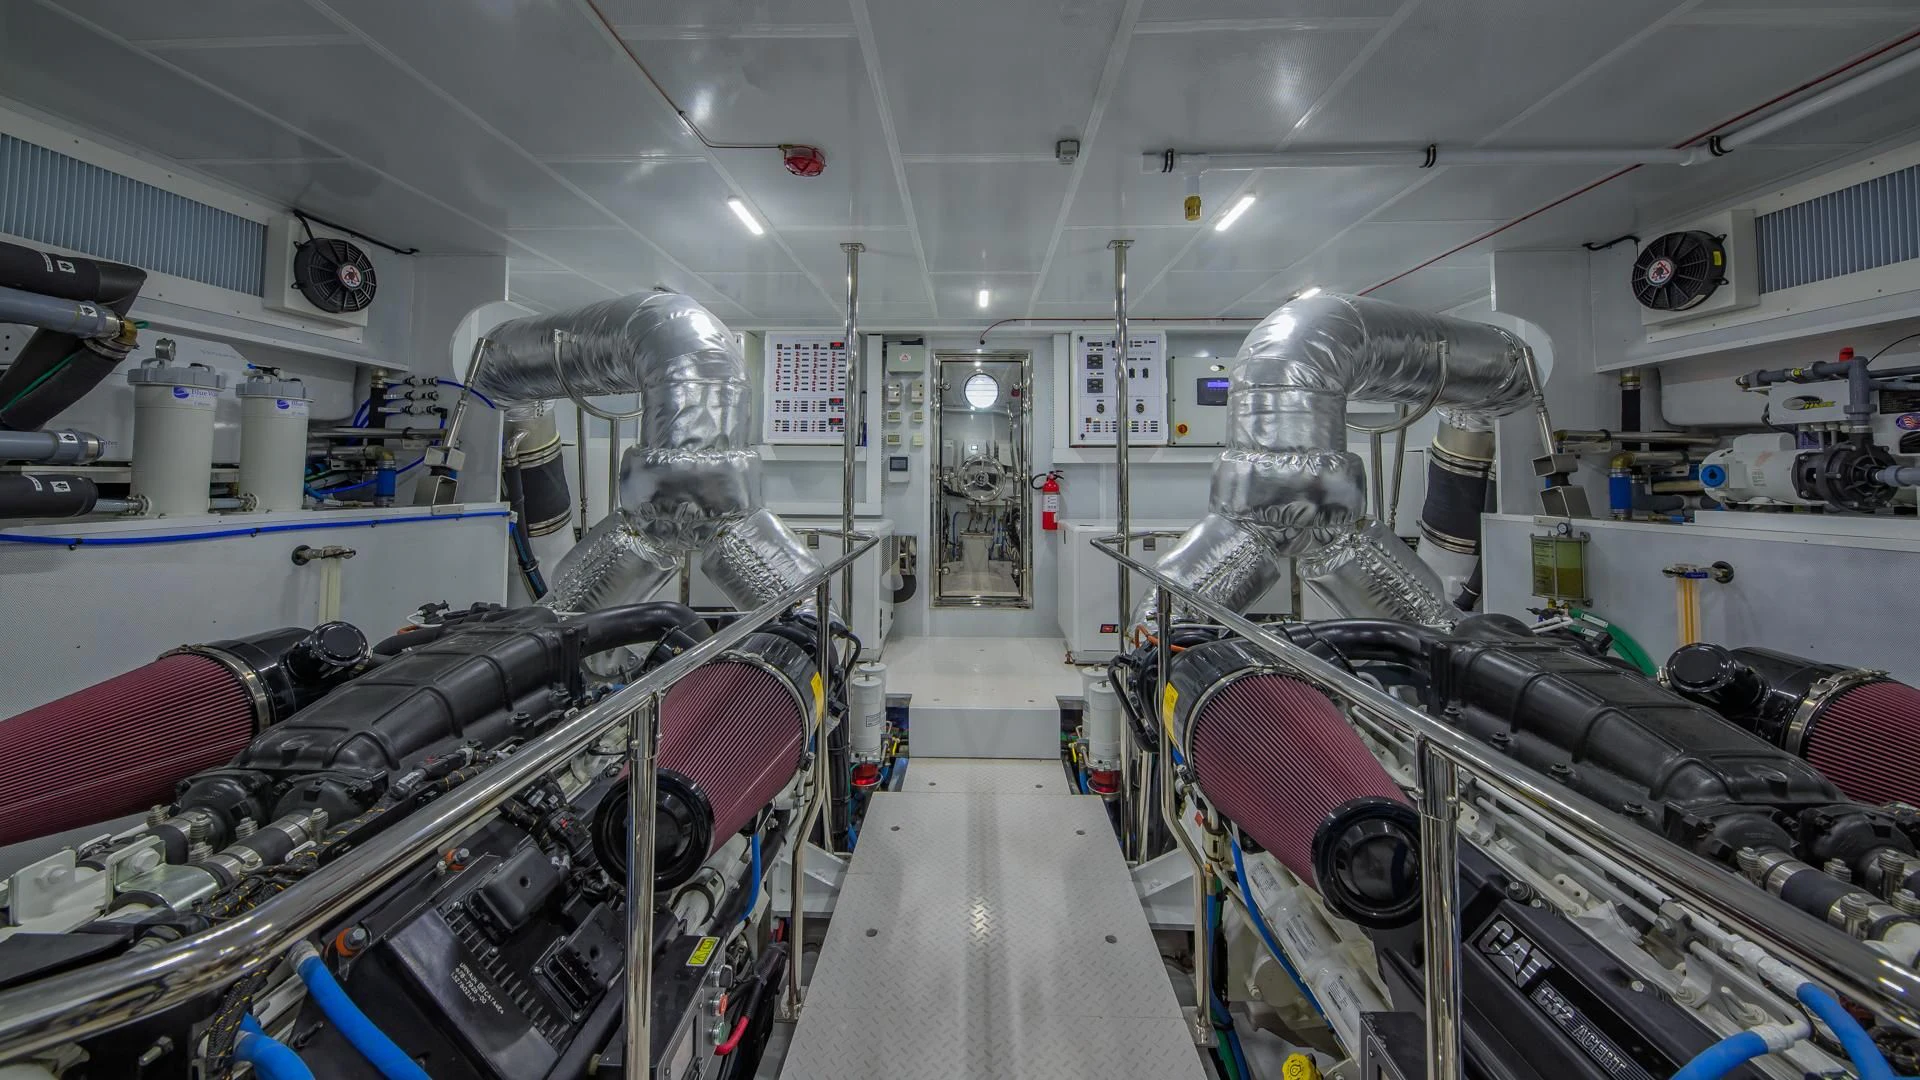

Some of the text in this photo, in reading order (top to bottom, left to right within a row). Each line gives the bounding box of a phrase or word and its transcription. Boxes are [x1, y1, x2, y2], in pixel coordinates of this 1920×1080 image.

[1478, 920, 1553, 989] CAT
[1535, 986, 1628, 1074] C32 ACERT
